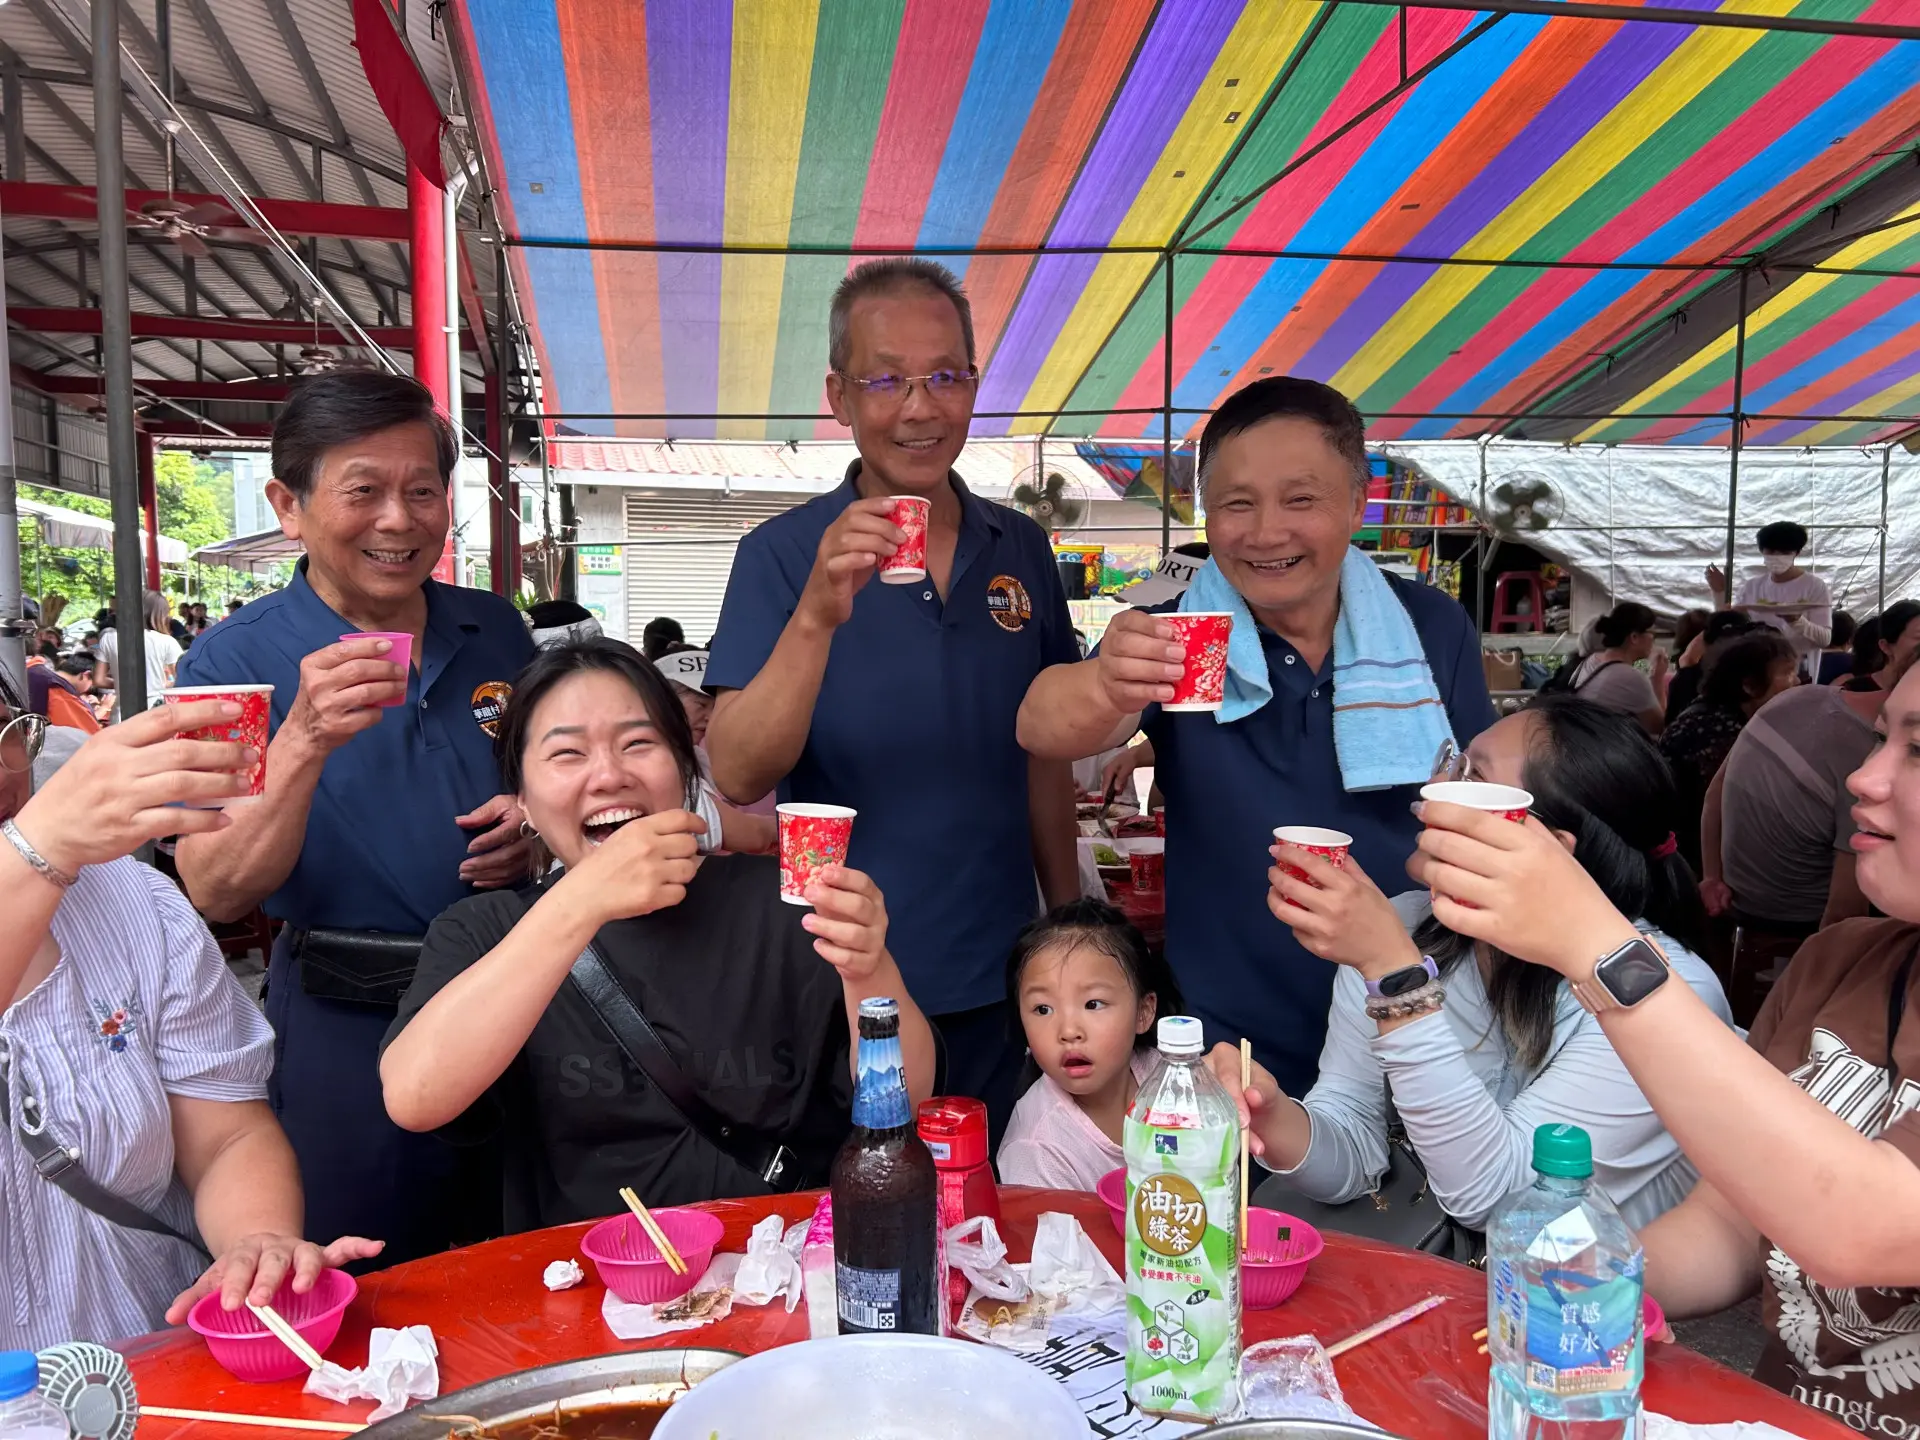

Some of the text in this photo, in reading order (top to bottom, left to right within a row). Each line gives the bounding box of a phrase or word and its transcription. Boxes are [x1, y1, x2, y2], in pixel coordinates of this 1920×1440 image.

[1141, 1180, 1204, 1227] 油切
[1148, 1216, 1192, 1252] 綠茶
[1560, 1301, 1601, 1324] 質感
[1559, 1332, 1600, 1354] 好水
[1151, 1385, 1191, 1401] 1000mL
